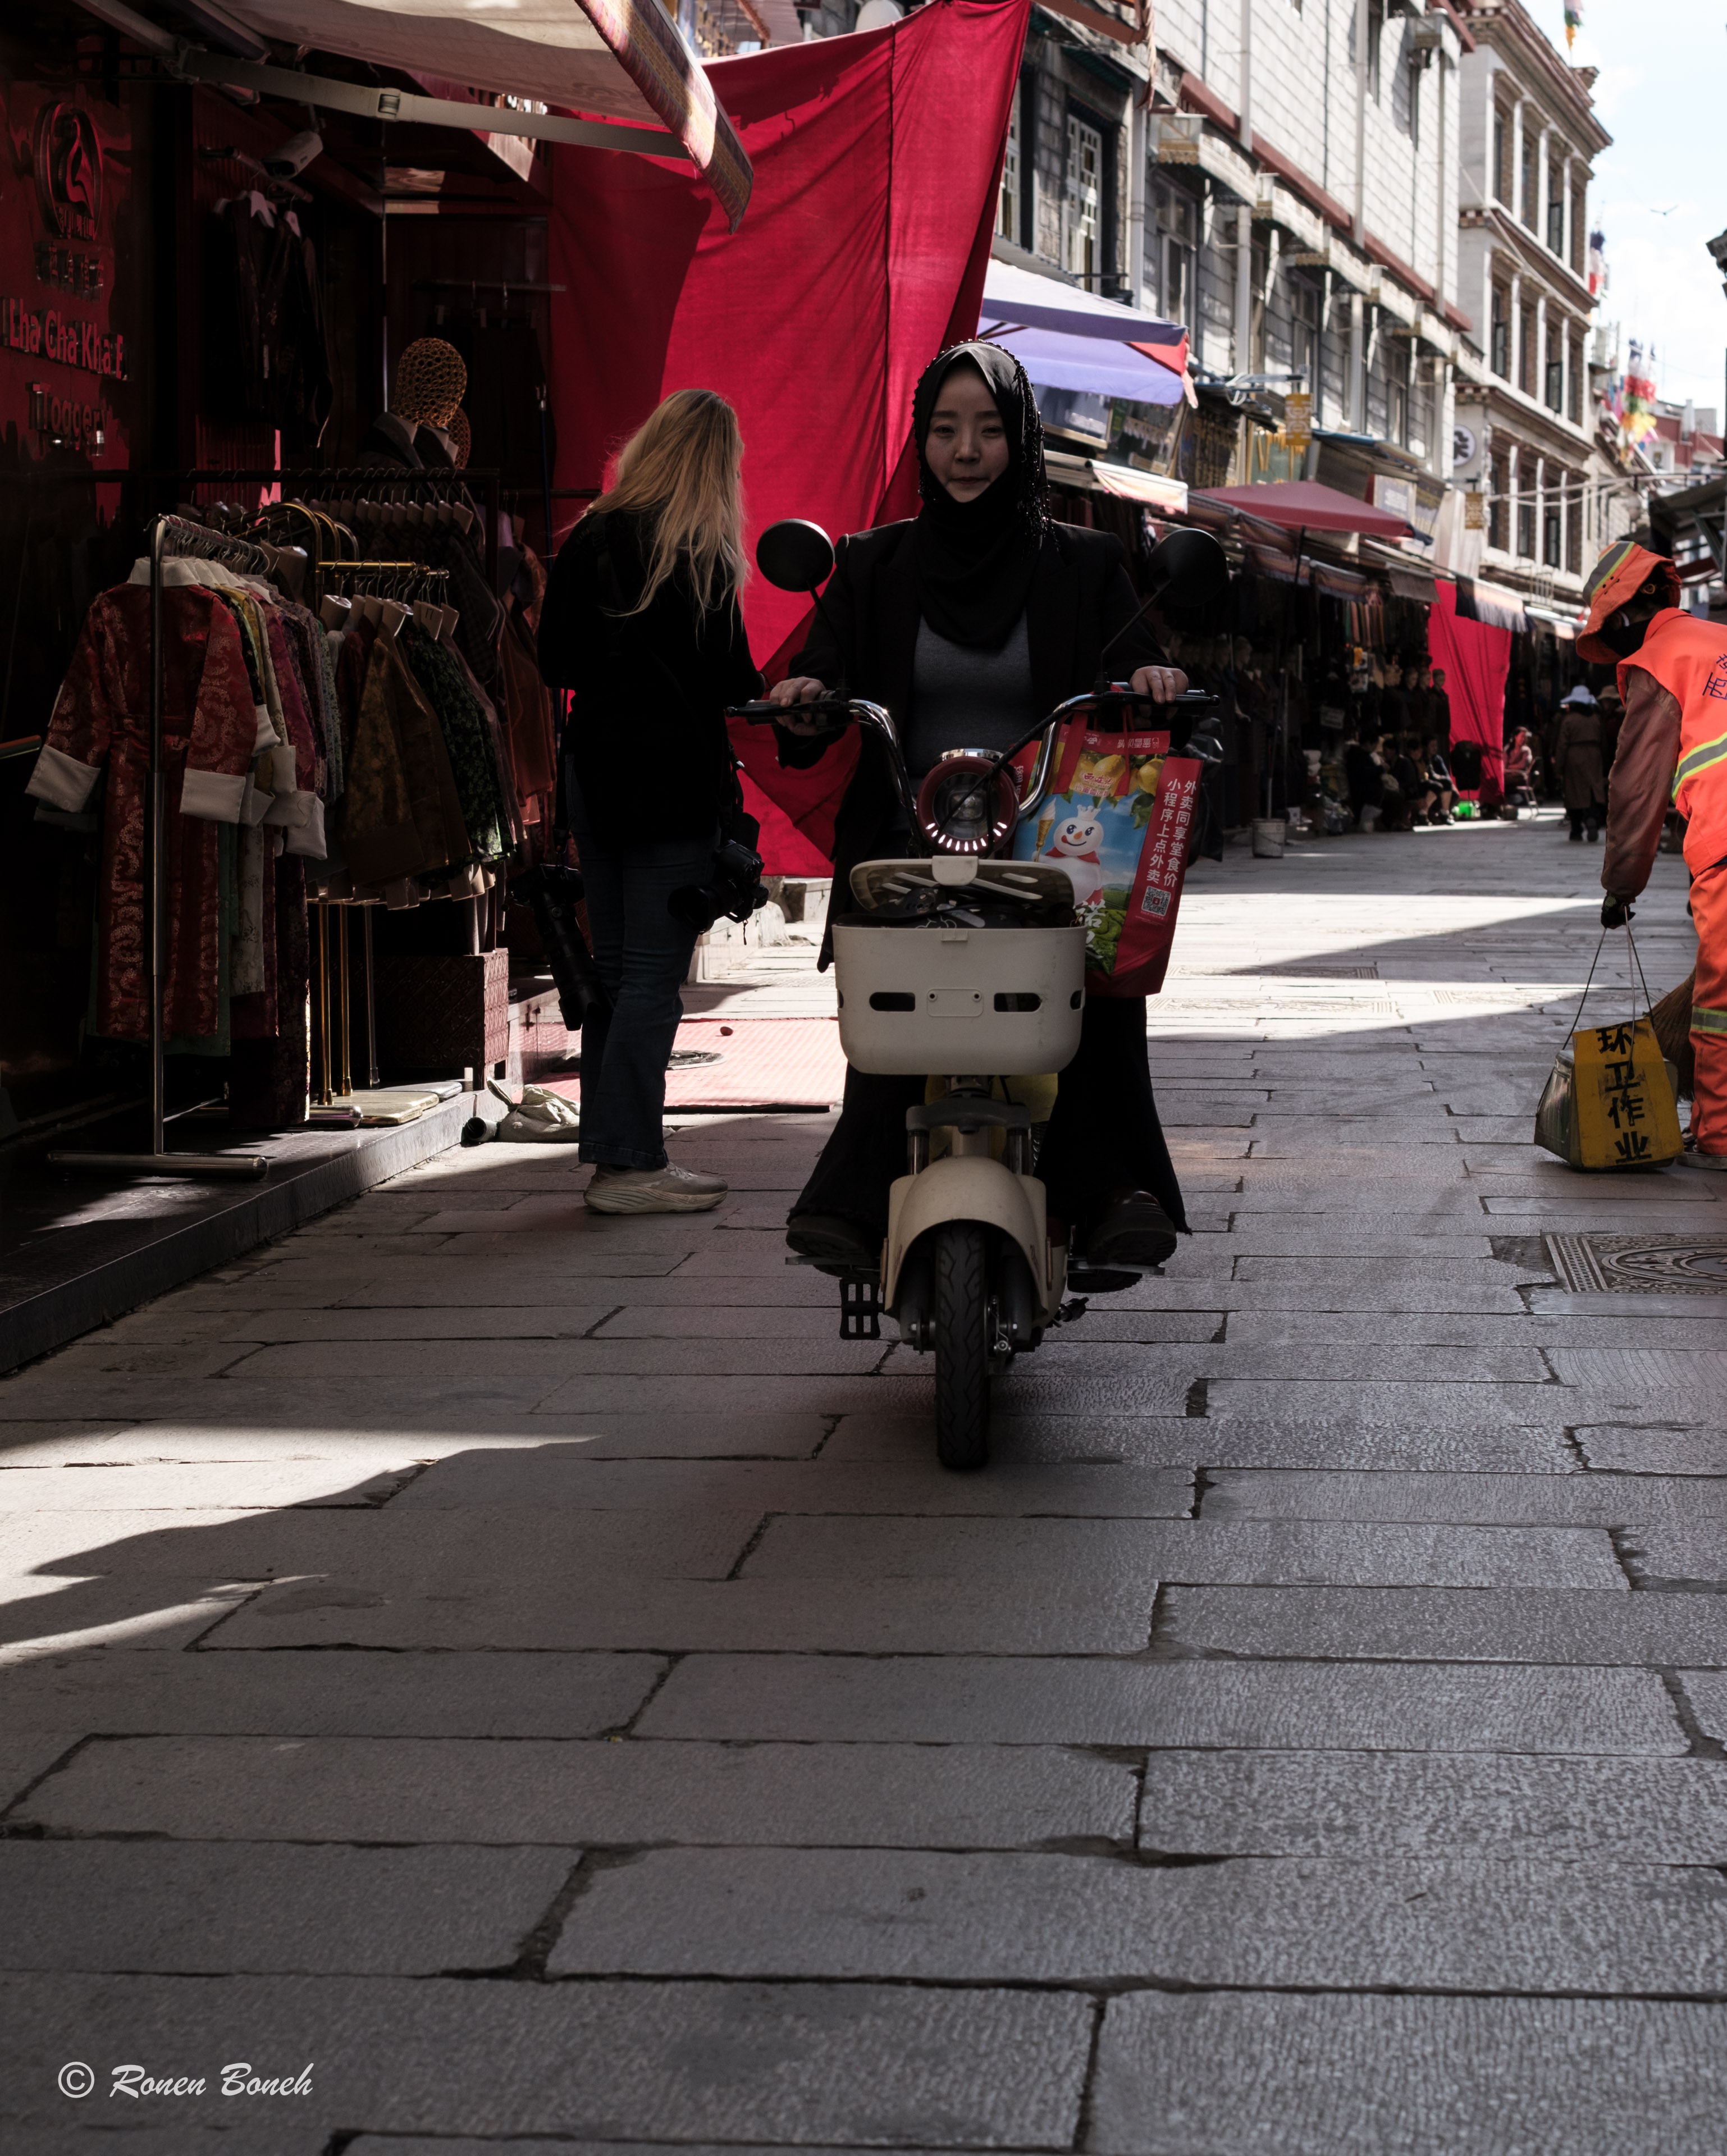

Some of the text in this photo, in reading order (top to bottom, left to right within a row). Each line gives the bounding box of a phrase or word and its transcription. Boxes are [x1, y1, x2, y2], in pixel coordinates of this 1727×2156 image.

[10, 298, 40, 353] Lha
[45, 309, 77, 364] Cha
[83, 322, 111, 374] Kha
[1146, 778, 1181, 884] 小程序上点外卖
[1164, 780, 1196, 887] 外卖同享堂食价
[1596, 1024, 1652, 1164] 环卫作业
